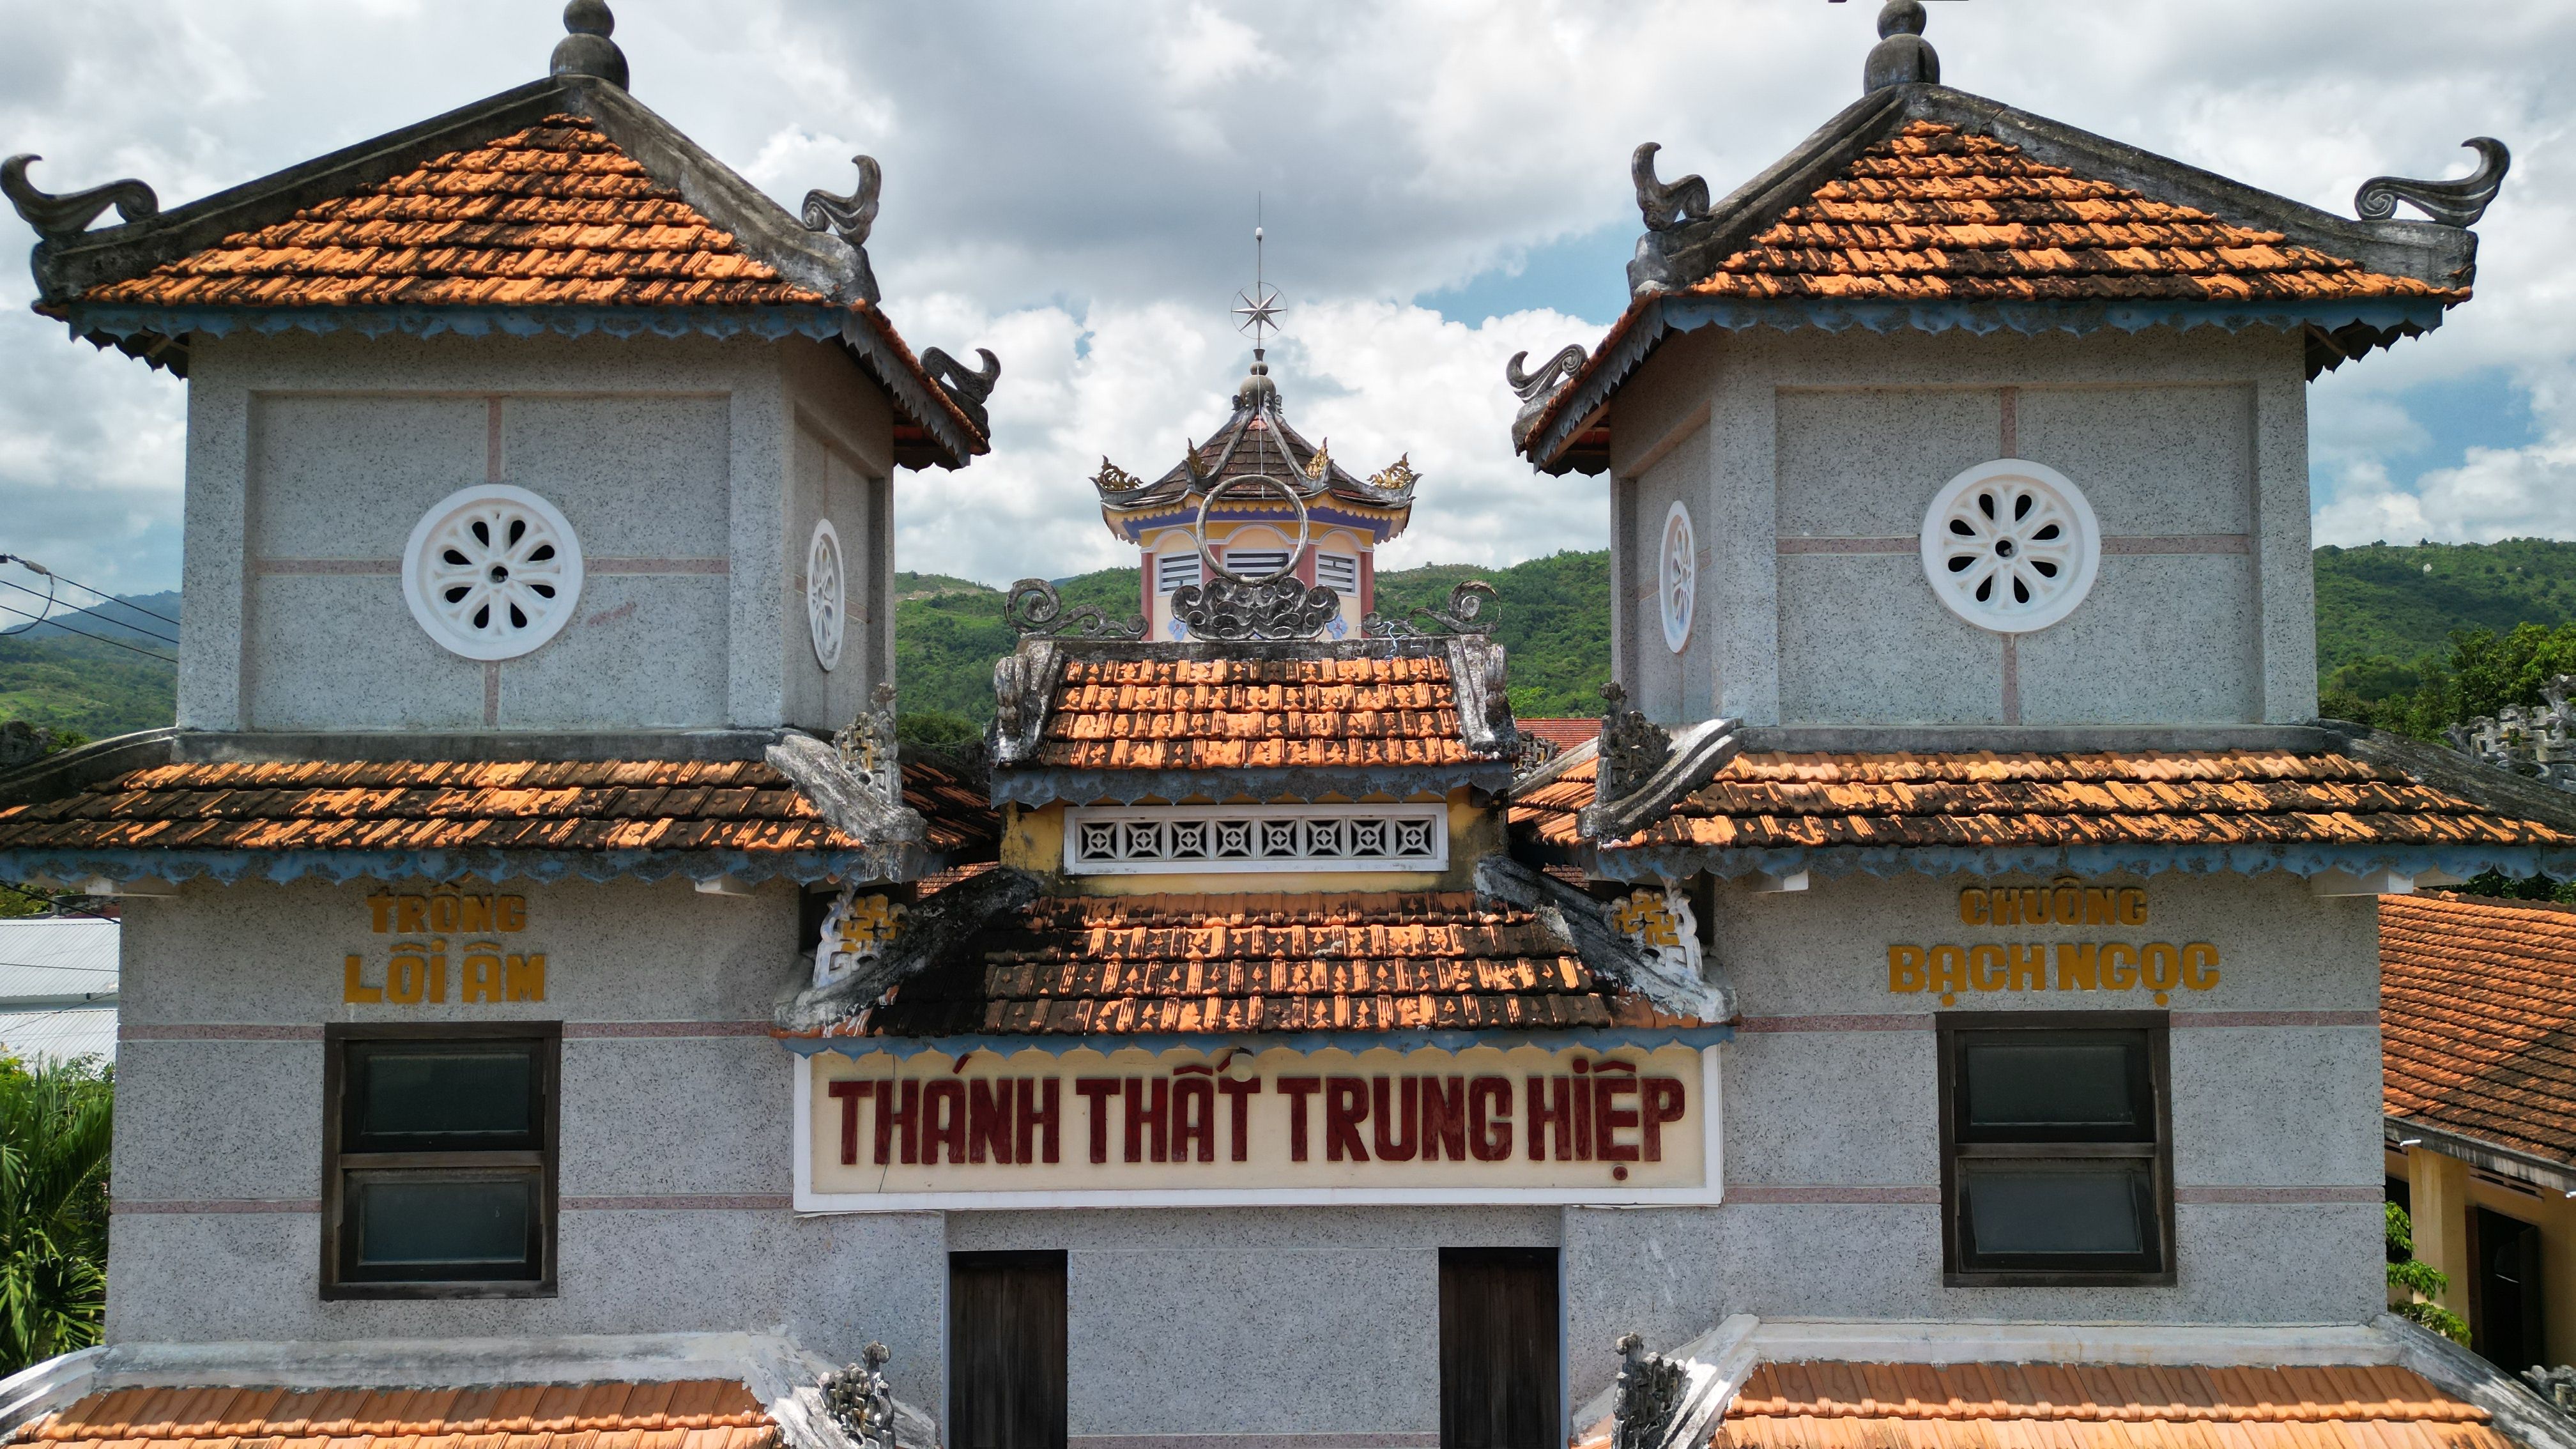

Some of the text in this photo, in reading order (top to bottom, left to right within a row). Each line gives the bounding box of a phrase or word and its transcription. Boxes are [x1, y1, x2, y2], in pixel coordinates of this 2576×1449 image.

[1959, 877, 2148, 926] CHUÔNG
[462, 941, 546, 1003] ÂM
[1889, 943, 2220, 1007] BẠCH NGỌC
[829, 1054, 1060, 1165] THÁNH
[1076, 1051, 1261, 1163] THẤT
[1277, 1076, 1513, 1162] TRUNG
